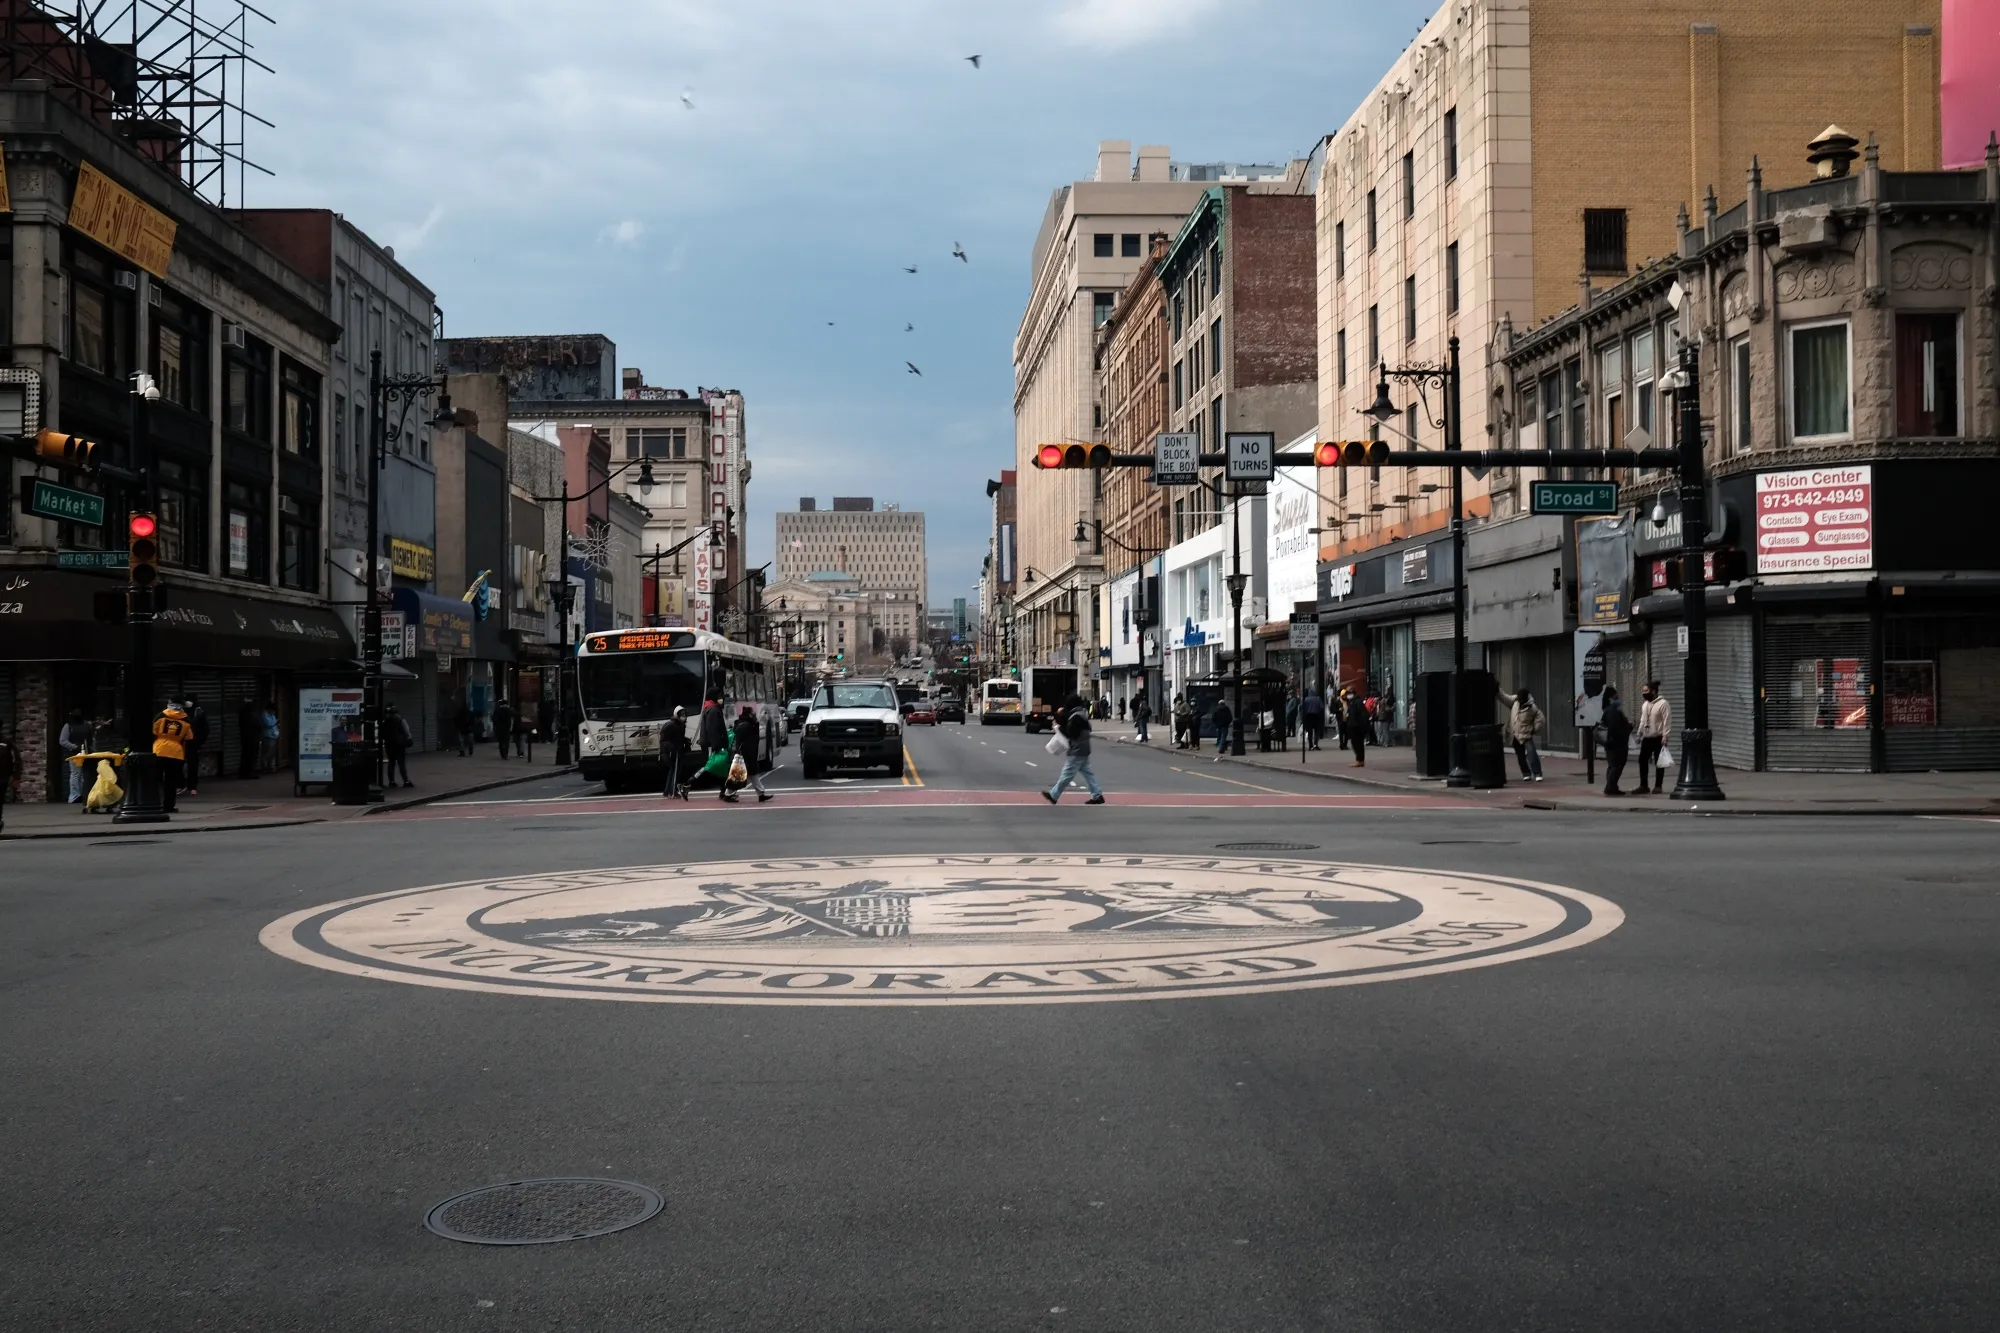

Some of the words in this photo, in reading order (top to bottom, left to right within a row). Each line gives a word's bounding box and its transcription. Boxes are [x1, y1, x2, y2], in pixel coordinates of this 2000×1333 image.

[1164, 436, 1189, 447] DON'T
[1241, 442, 1260, 454] NO
[1163, 449, 1190, 460] BLOCK
[1159, 461, 1174, 472] THE
[1179, 461, 1195, 472] BOX
[1232, 460, 1268, 470] TURNS
[1765, 474, 1807, 489] Vision
[1812, 470, 1862, 485] Center
[711, 405, 726, 571] HOWARD
[40, 489, 86, 516] Market
[1540, 489, 1594, 506] Broad
[1600, 490, 1609, 499] St
[1763, 488, 1864, 508] 973-642-4949
[1766, 515, 1802, 526] Contacts
[1821, 513, 1837, 524] Eye
[1839, 511, 1862, 521] Exam
[1768, 535, 1800, 545] Glasses
[1818, 531, 1866, 542] Sunglasses
[696, 541, 709, 592] JAYS
[1760, 556, 1820, 569] Insurance
[1823, 553, 1869, 567] Special
[664, 582, 676, 612] WIG
[594, 636, 608, 650] 25
[1891, 696, 1908, 706] Buy
[1892, 705, 1908, 714] Get
[1909, 705, 1927, 714] One
[1892, 714, 1928, 723] FREE!!
[596, 734, 614, 742] 5815
[483, 866, 707, 892] CITY
[750, 858, 877, 870] OF
[936, 857, 1386, 878] NEWARK
[368, 938, 1318, 989] INCORPORATED
[1340, 920, 1528, 955] 1836
